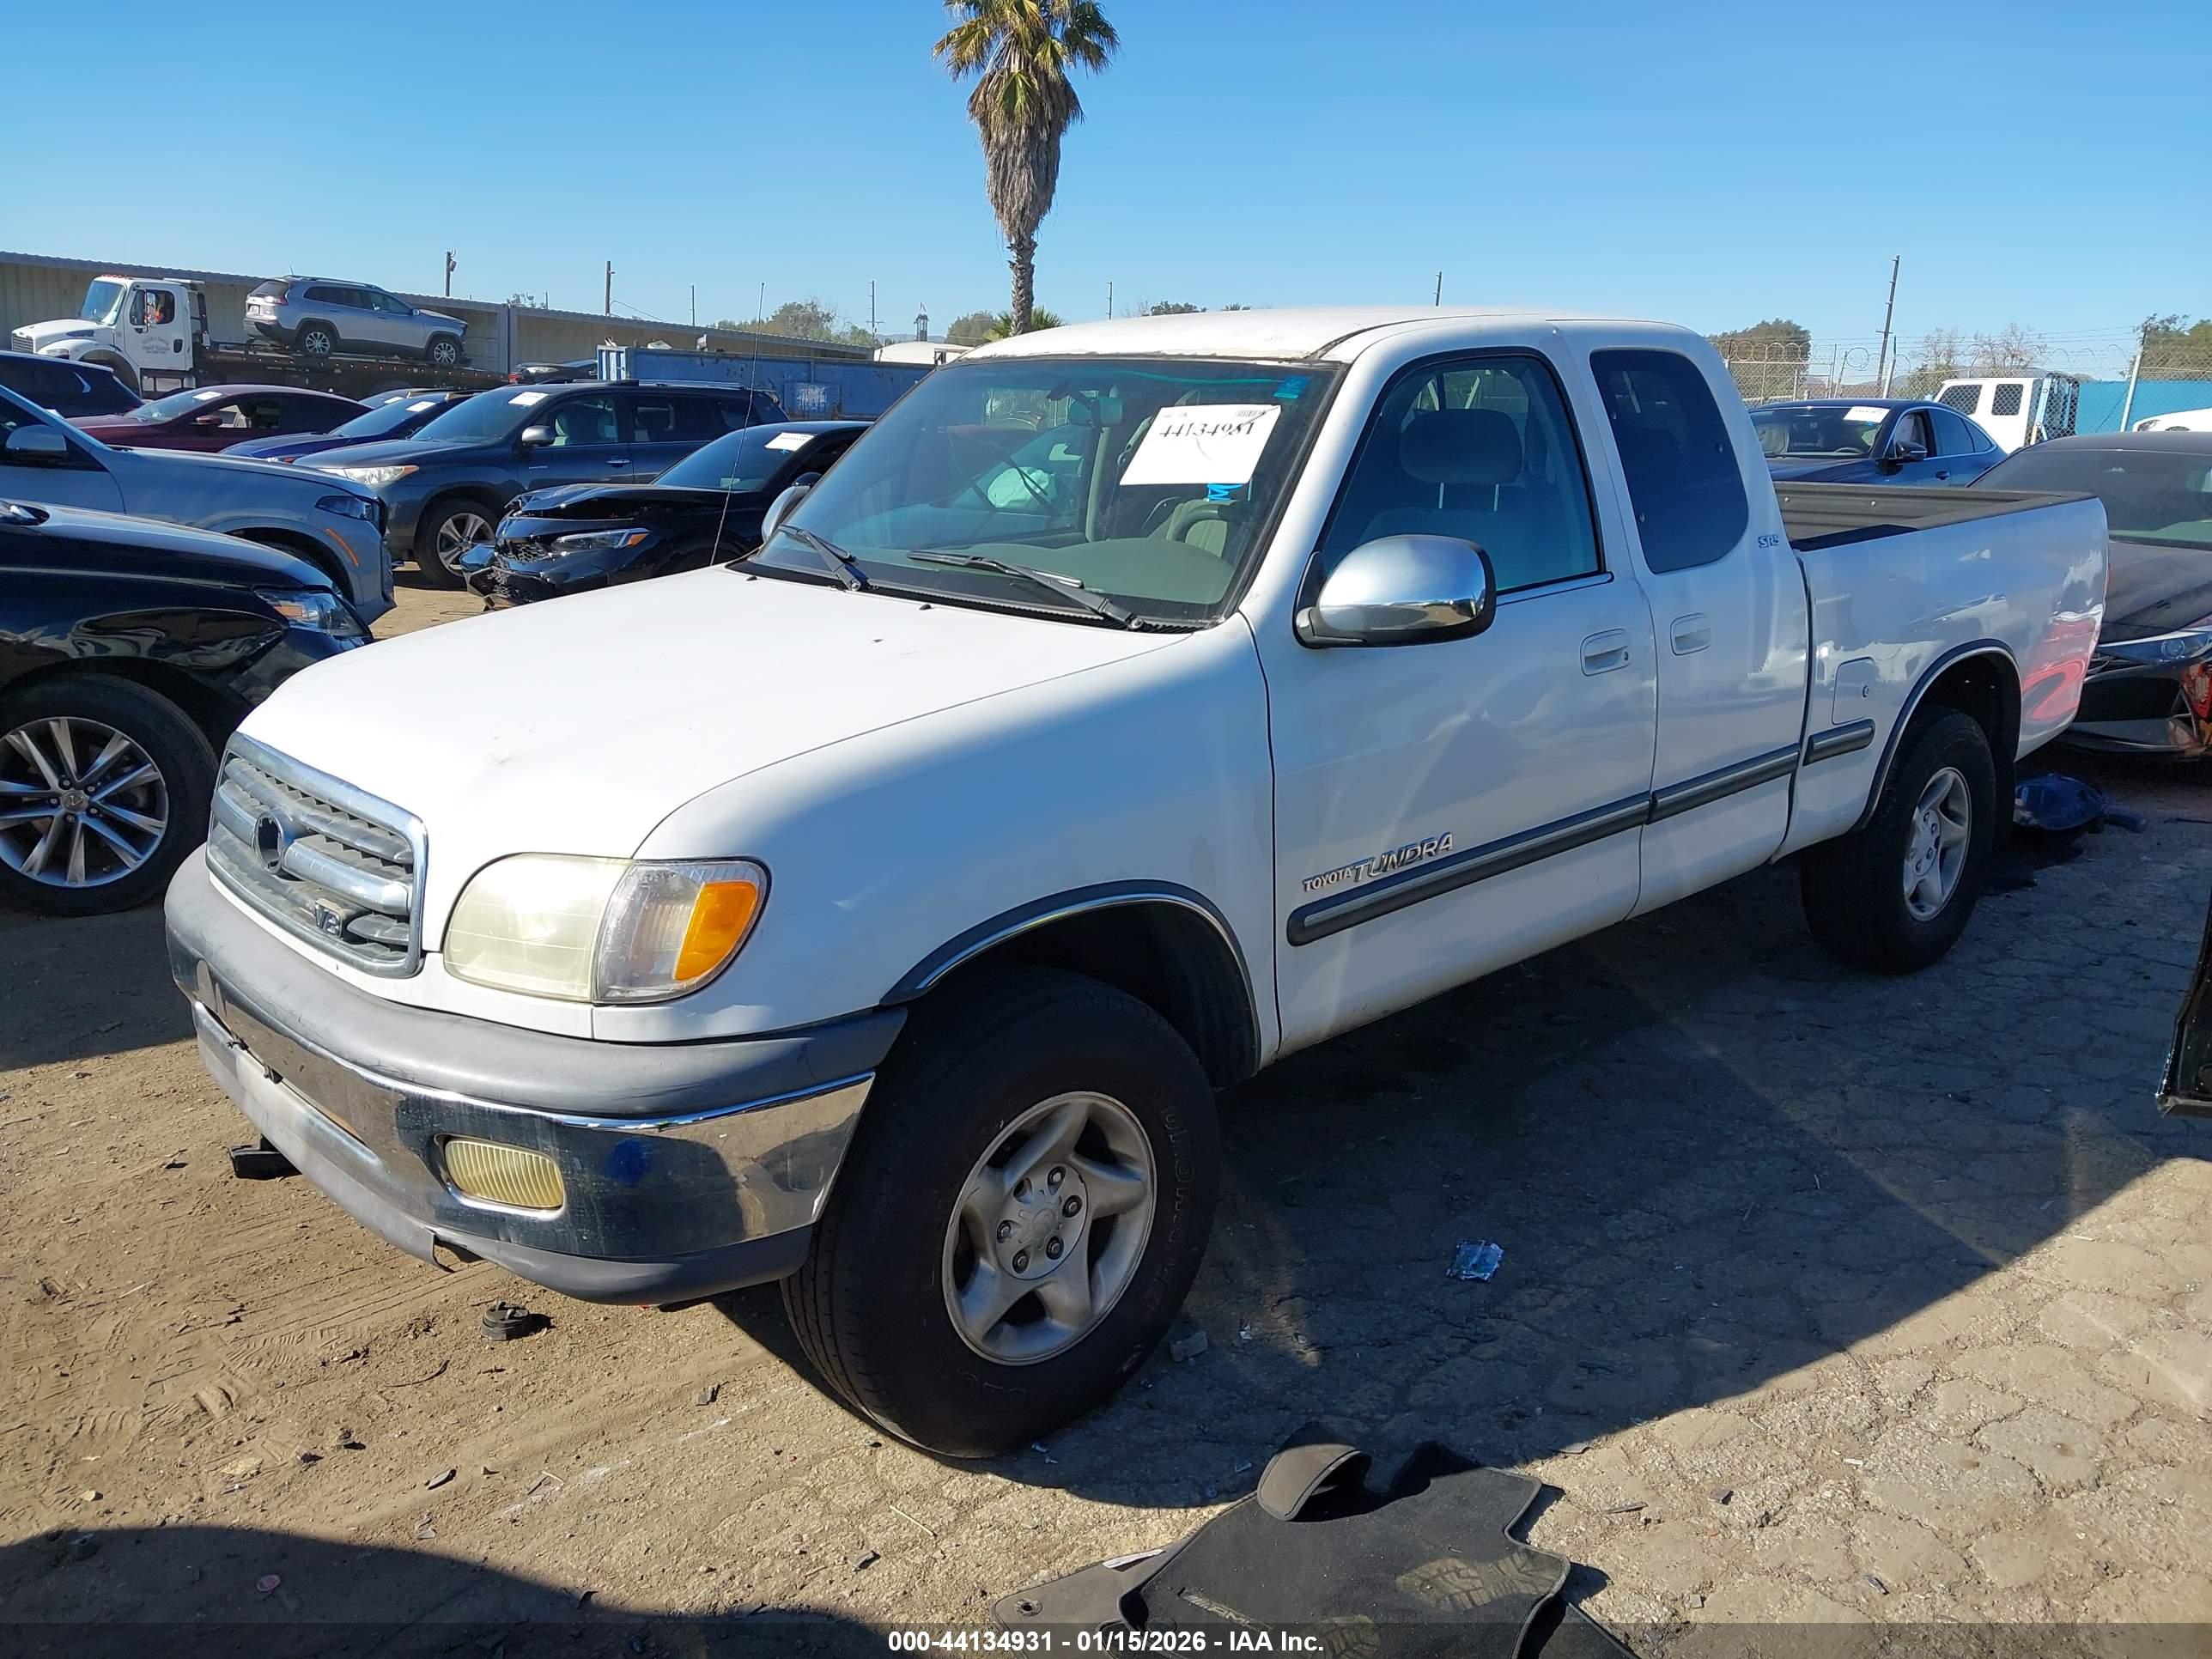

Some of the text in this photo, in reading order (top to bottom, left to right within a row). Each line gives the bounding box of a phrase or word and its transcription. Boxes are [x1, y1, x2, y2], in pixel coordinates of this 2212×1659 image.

[1302, 831, 1455, 893] TOYOTA TUNDRA
[314, 903, 342, 938] V8
